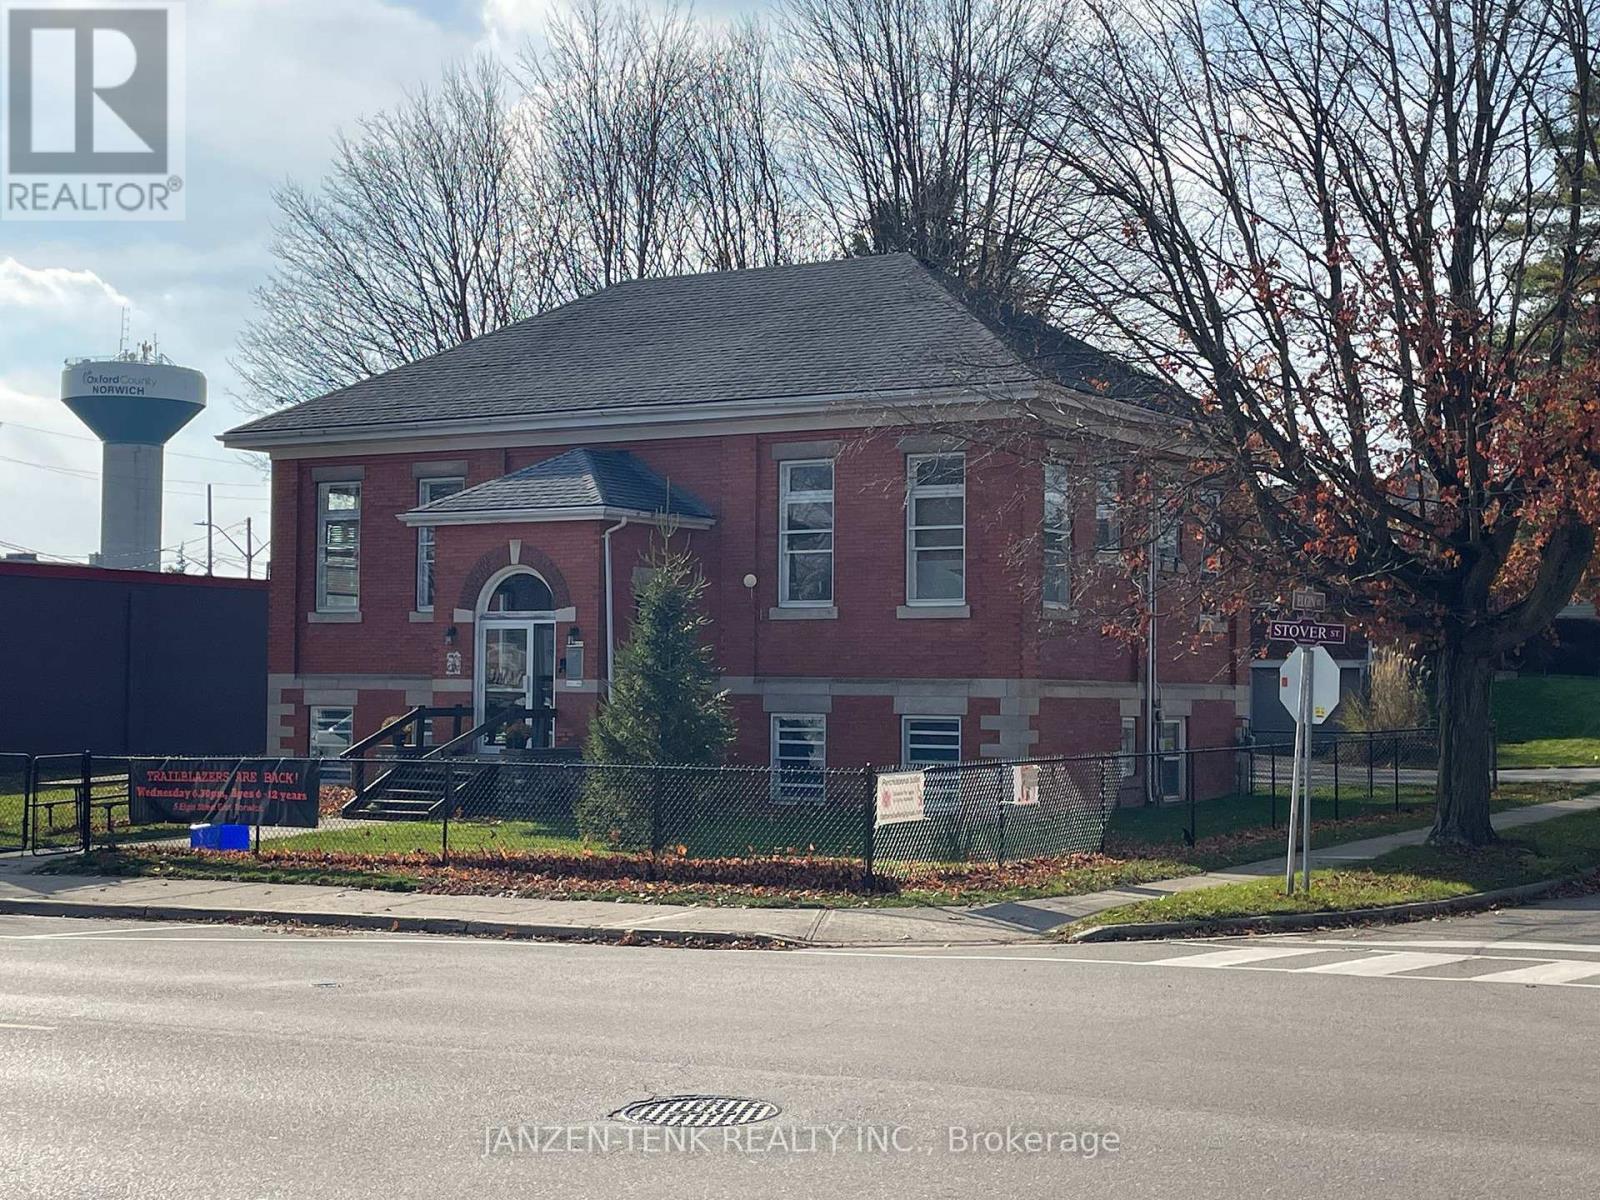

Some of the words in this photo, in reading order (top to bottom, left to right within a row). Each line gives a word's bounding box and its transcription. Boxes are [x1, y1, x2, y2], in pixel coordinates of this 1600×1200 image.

[92, 385, 145, 396] NORWICH
[1273, 624, 1327, 639] STOVER
[1330, 630, 1341, 638] ST
[146, 771, 230, 783] TRAILBLAZERS
[235, 771, 257, 783] ARE
[264, 771, 299, 784] BACK!
[136, 786, 191, 799] Wednesday
[280, 791, 308, 802] years
